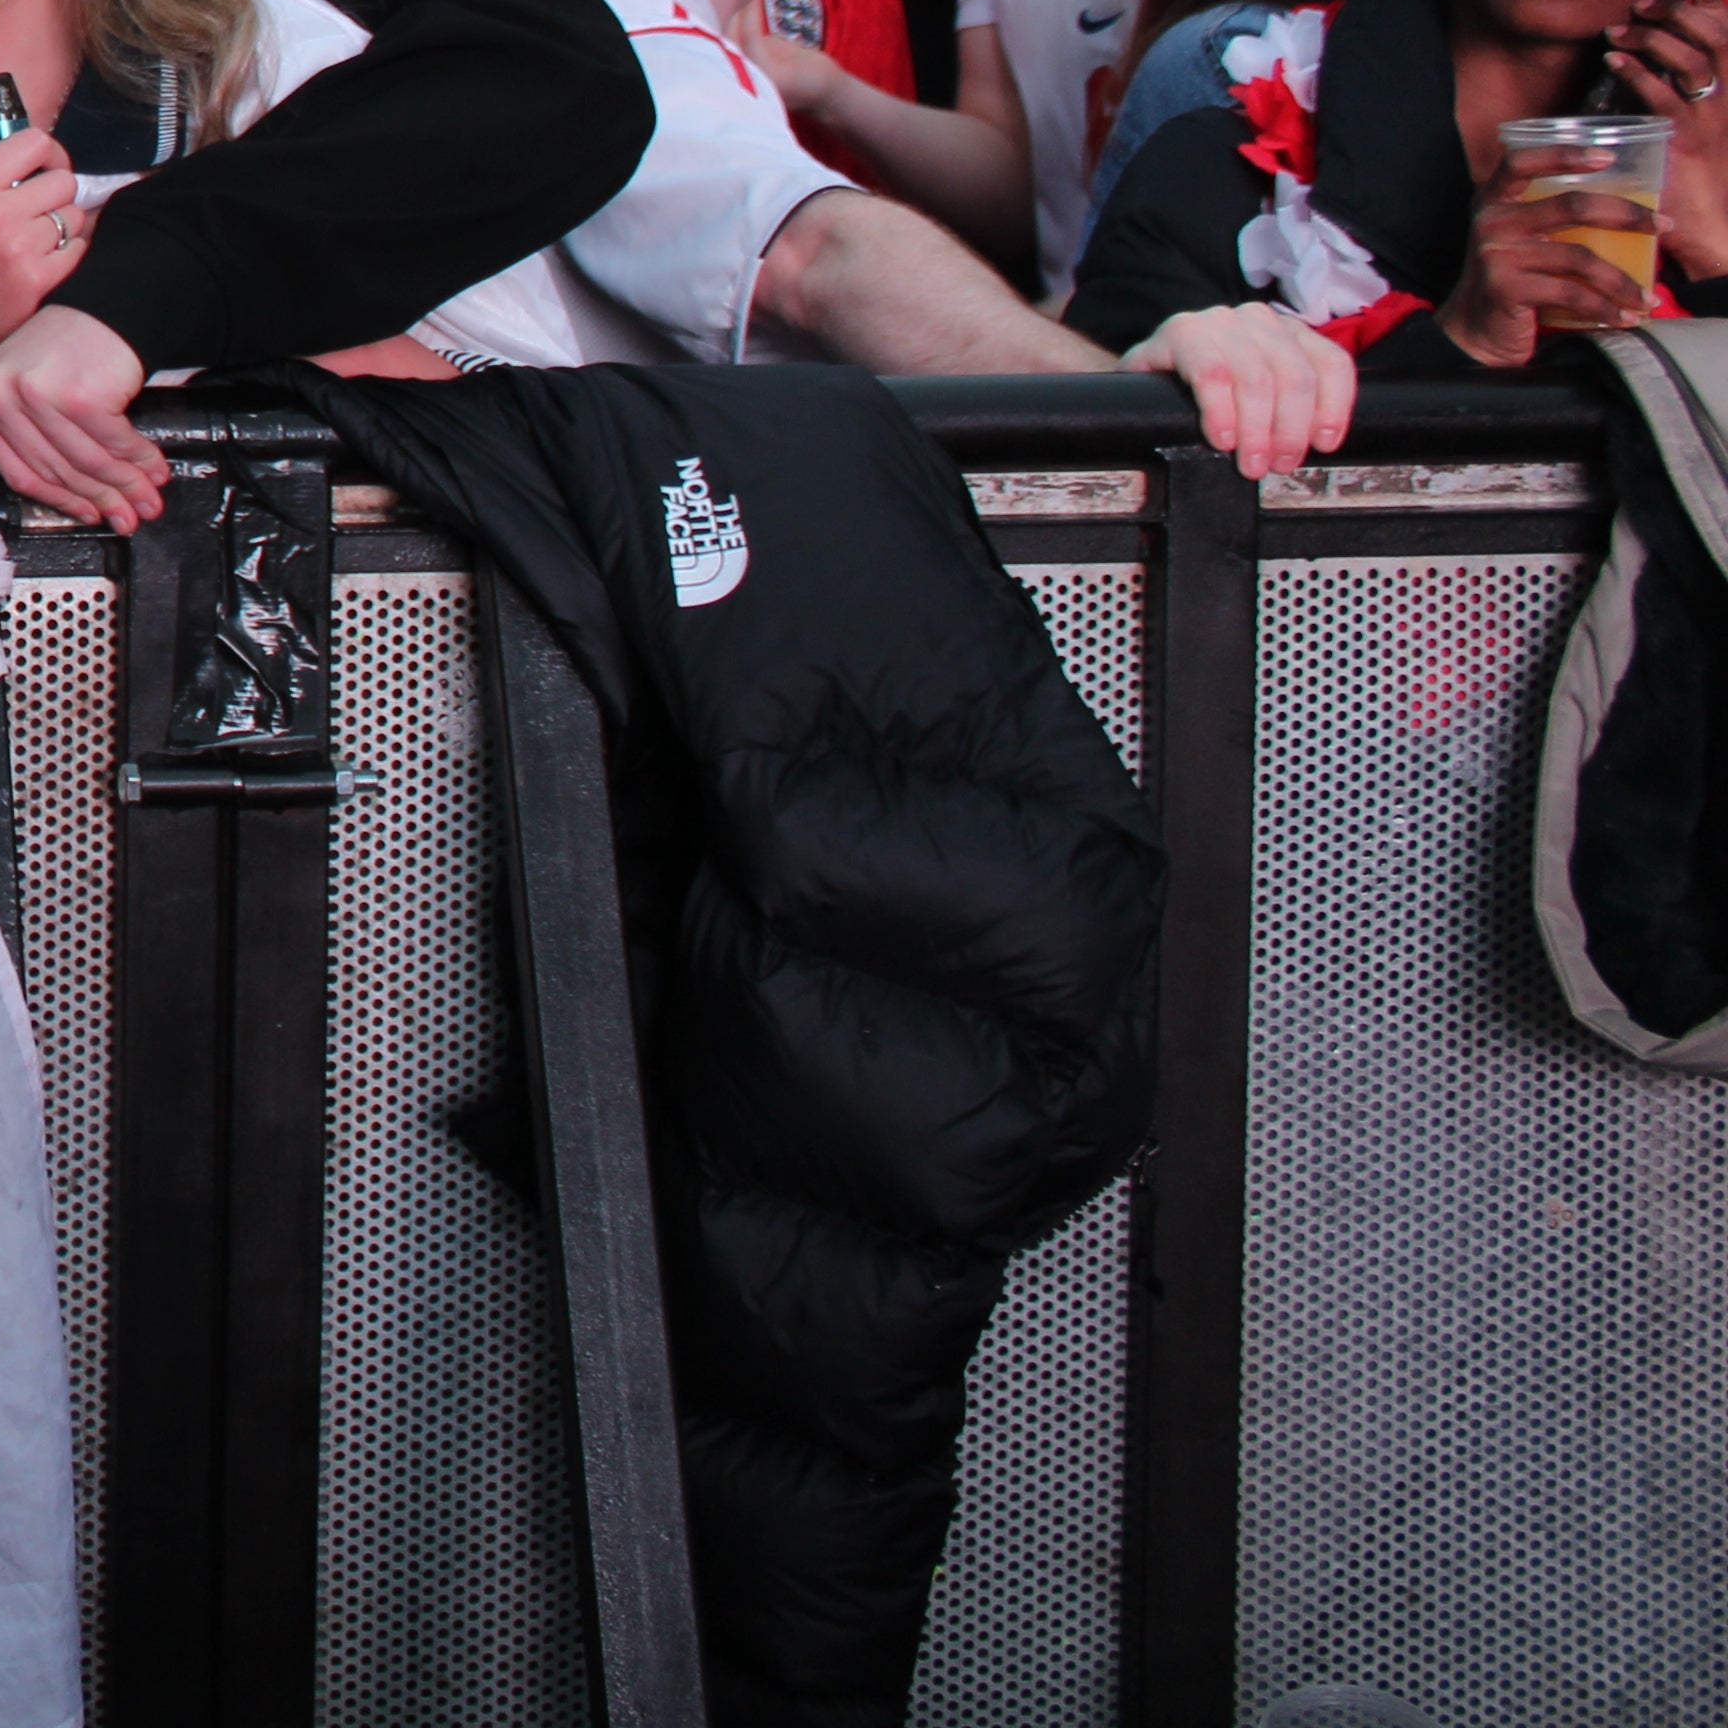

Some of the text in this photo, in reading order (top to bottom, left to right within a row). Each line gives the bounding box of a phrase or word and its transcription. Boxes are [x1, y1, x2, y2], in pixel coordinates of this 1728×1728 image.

[659, 485, 695, 555] FACE
[675, 457, 721, 553] NORTH
[713, 494, 746, 550] THE
